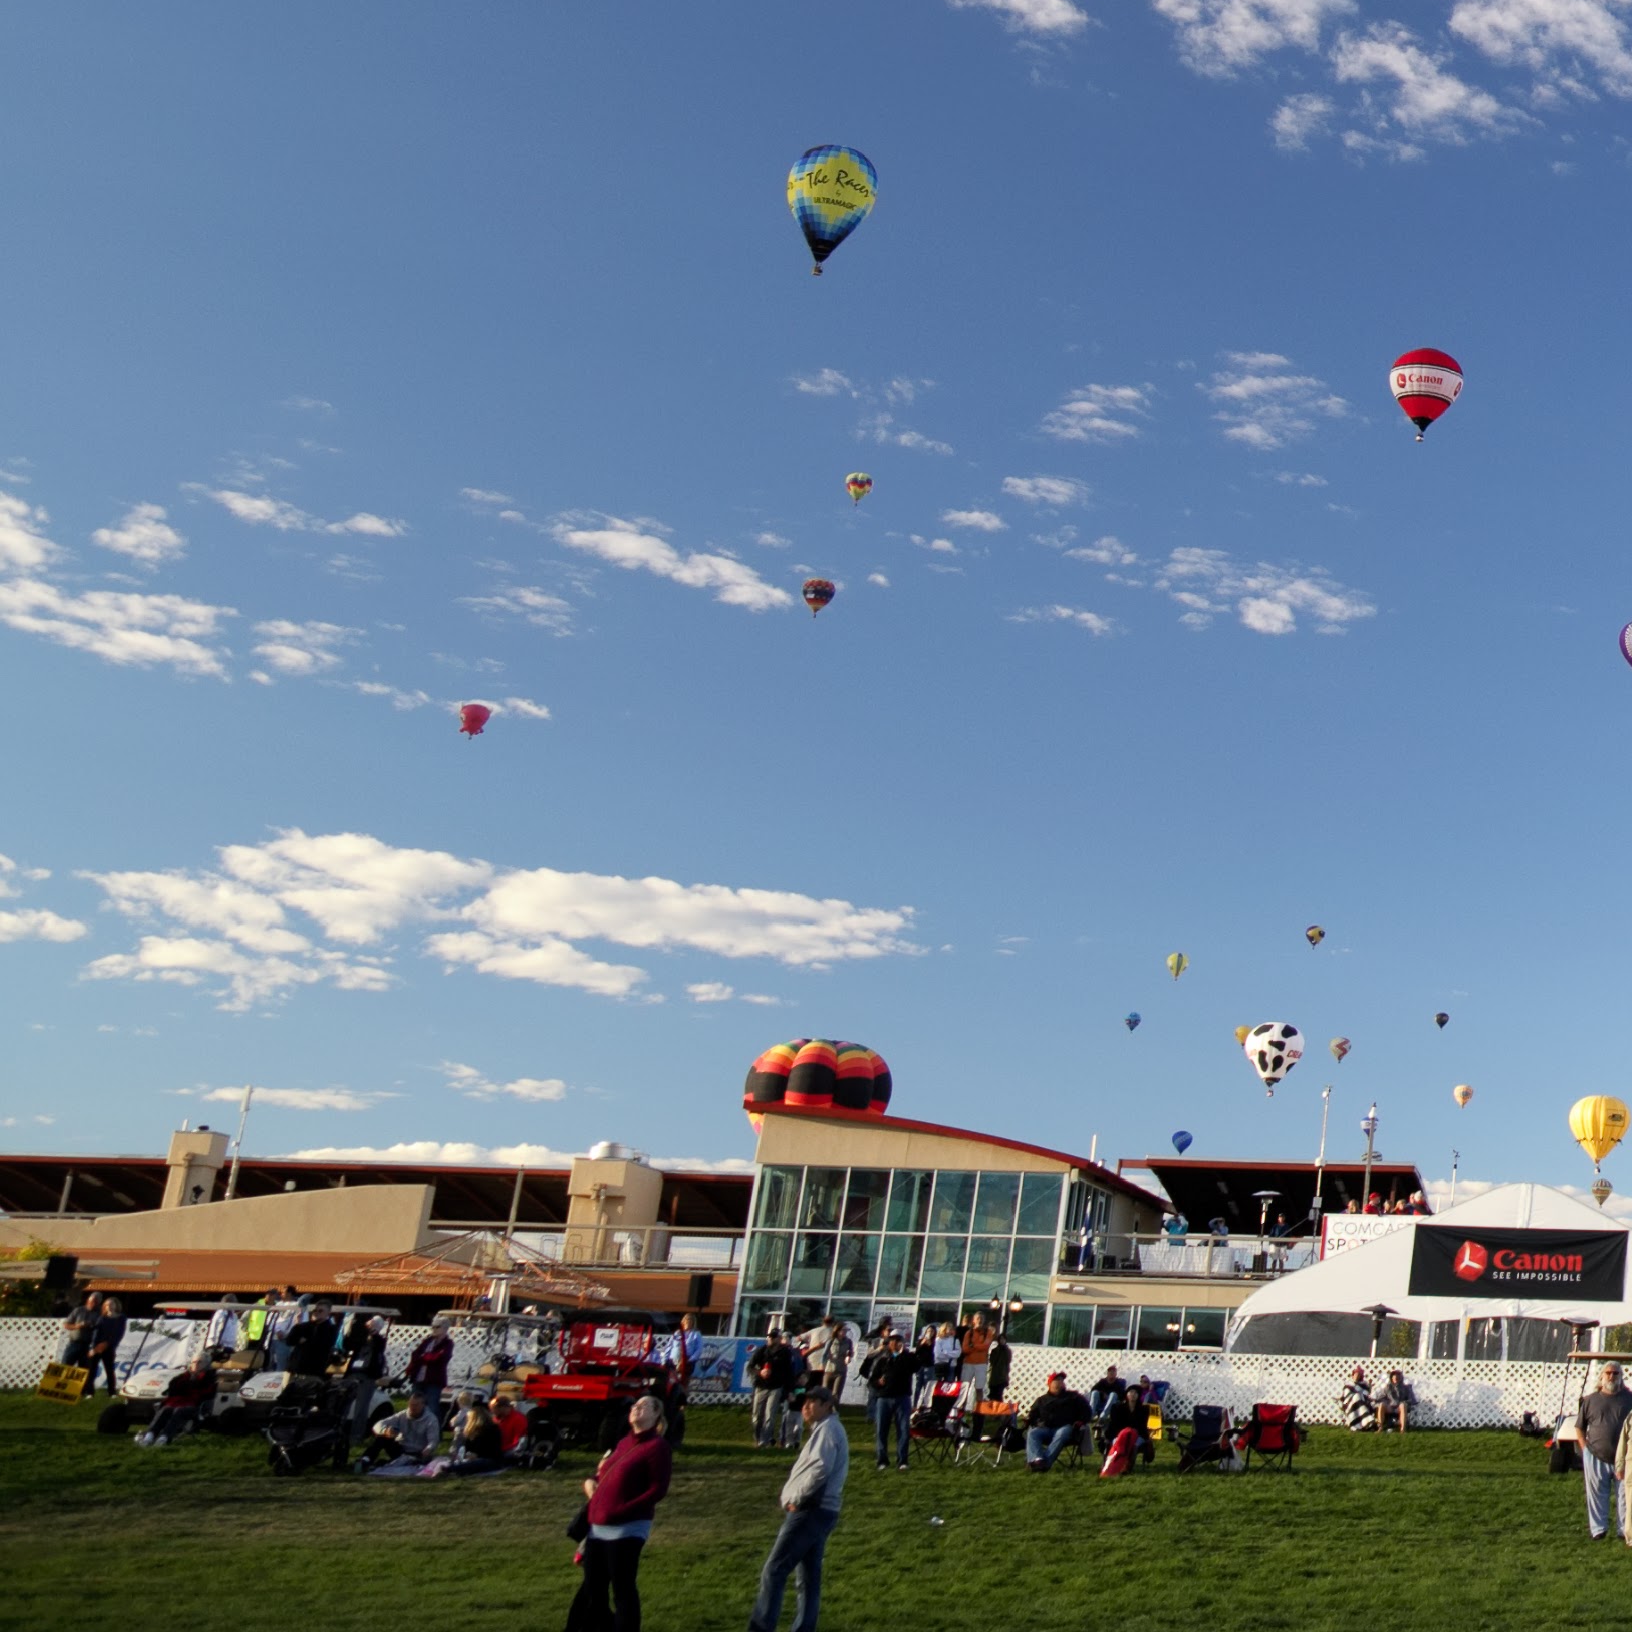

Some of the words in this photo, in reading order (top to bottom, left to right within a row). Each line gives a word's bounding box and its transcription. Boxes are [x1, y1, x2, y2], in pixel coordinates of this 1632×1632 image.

[806, 168, 830, 189] The
[1408, 373, 1443, 385] Canon
[1493, 1249, 1582, 1272] Canon
[1492, 1271, 1511, 1280] SEE
[1516, 1272, 1582, 1282] IMPOSSIBLE
